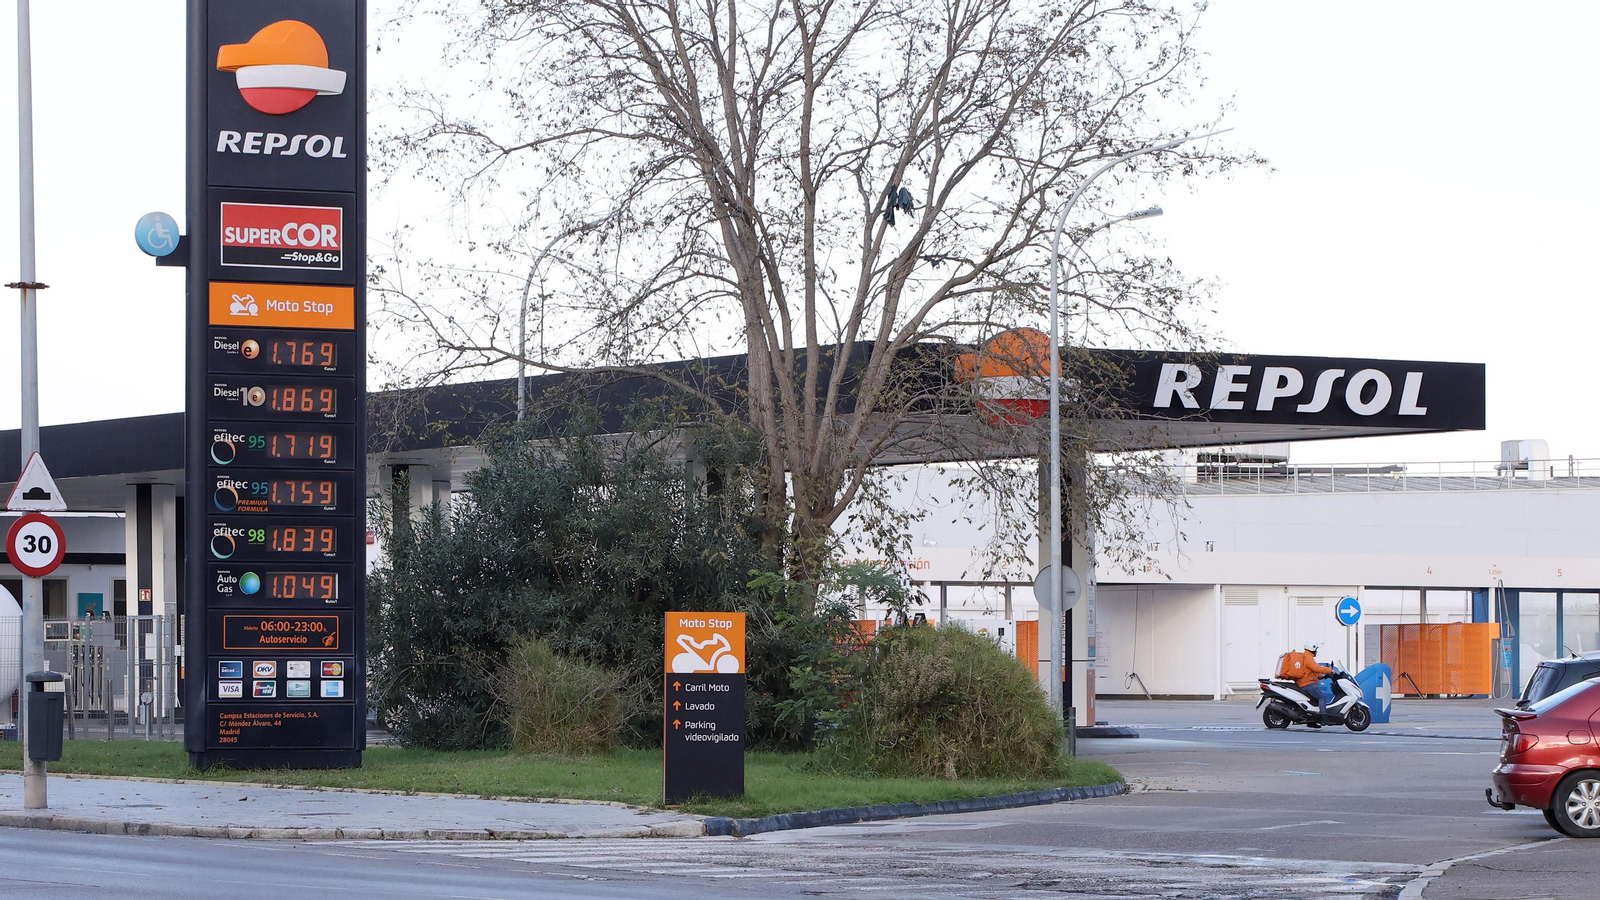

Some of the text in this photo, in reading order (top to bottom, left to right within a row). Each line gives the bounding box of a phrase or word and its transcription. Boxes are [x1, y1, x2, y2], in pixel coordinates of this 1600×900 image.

[216, 130, 347, 158] REPSOL
[291, 251, 339, 264] Stop&Go
[266, 299, 334, 316] Moto Stop
[213, 340, 240, 350] Diesel
[272, 341, 333, 365] 1.769
[213, 387, 240, 397] Diesel
[1152, 362, 1428, 416] REPSOL
[271, 387, 333, 412] 1.869
[213, 433, 266, 448] efitec 95
[271, 434, 333, 458] 1.719
[216, 479, 269, 495] efitec 95
[271, 481, 333, 504] 1.759
[213, 527, 265, 542] efitec 98
[272, 528, 334, 552] 1.839
[23, 534, 52, 554] 30
[1002, 560, 1007, 569] 2
[1426, 566, 1433, 575] 4
[1557, 568, 1563, 577] 5
[216, 574, 238, 583] Auto
[216, 584, 233, 593] Gas
[272, 575, 334, 599] 1.049
[679, 618, 733, 630] Moto Stop
[915, 615, 922, 625] 7
[259, 634, 308, 644] Autoservicio
[222, 685, 240, 693] VISA
[685, 683, 730, 692] Carril Moto
[685, 702, 715, 711] Lavado
[219, 712, 243, 720] Campsa
[684, 720, 716, 731] Parking
[684, 733, 739, 743] videovigilado
